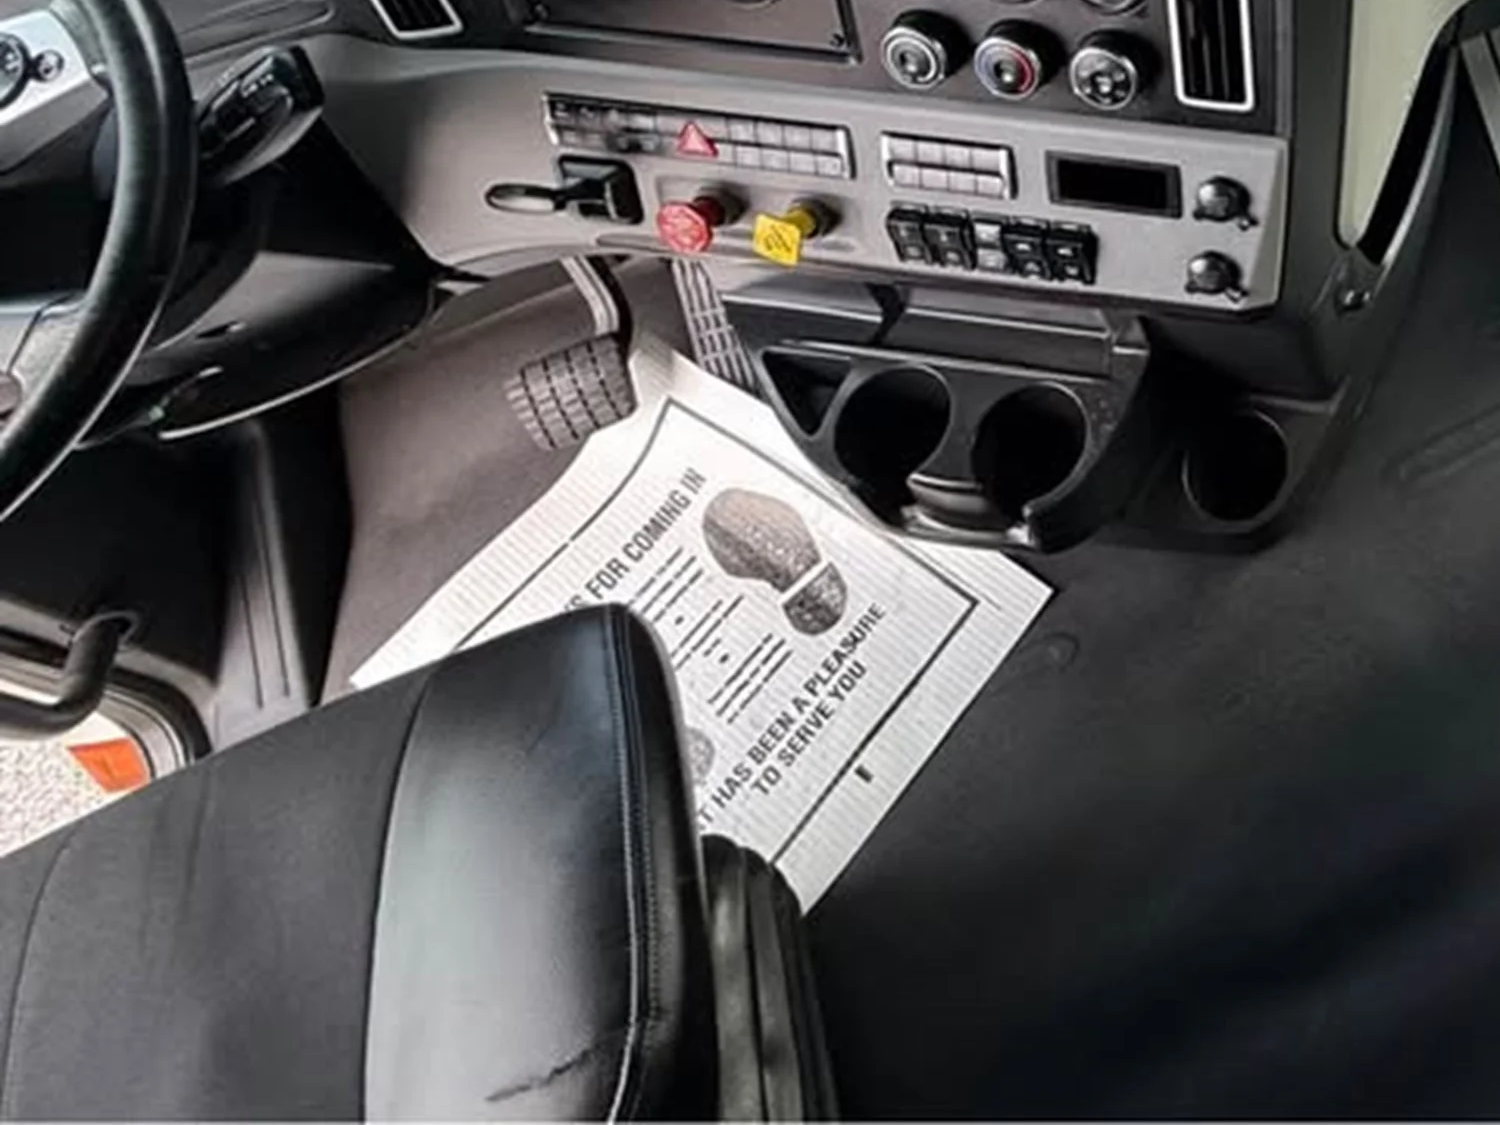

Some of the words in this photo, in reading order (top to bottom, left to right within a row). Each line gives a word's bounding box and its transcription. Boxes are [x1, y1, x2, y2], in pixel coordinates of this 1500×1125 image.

[584, 557, 631, 600] FOR
[621, 488, 693, 563] COMING
[679, 466, 707, 495] IN
[710, 761, 754, 809] HAS
[746, 710, 796, 766] BEEN
[790, 696, 811, 715] A
[803, 601, 887, 698] PLEASURE
[750, 764, 783, 797] TO
[776, 701, 836, 768] SERVE
[826, 660, 868, 703] YOU
